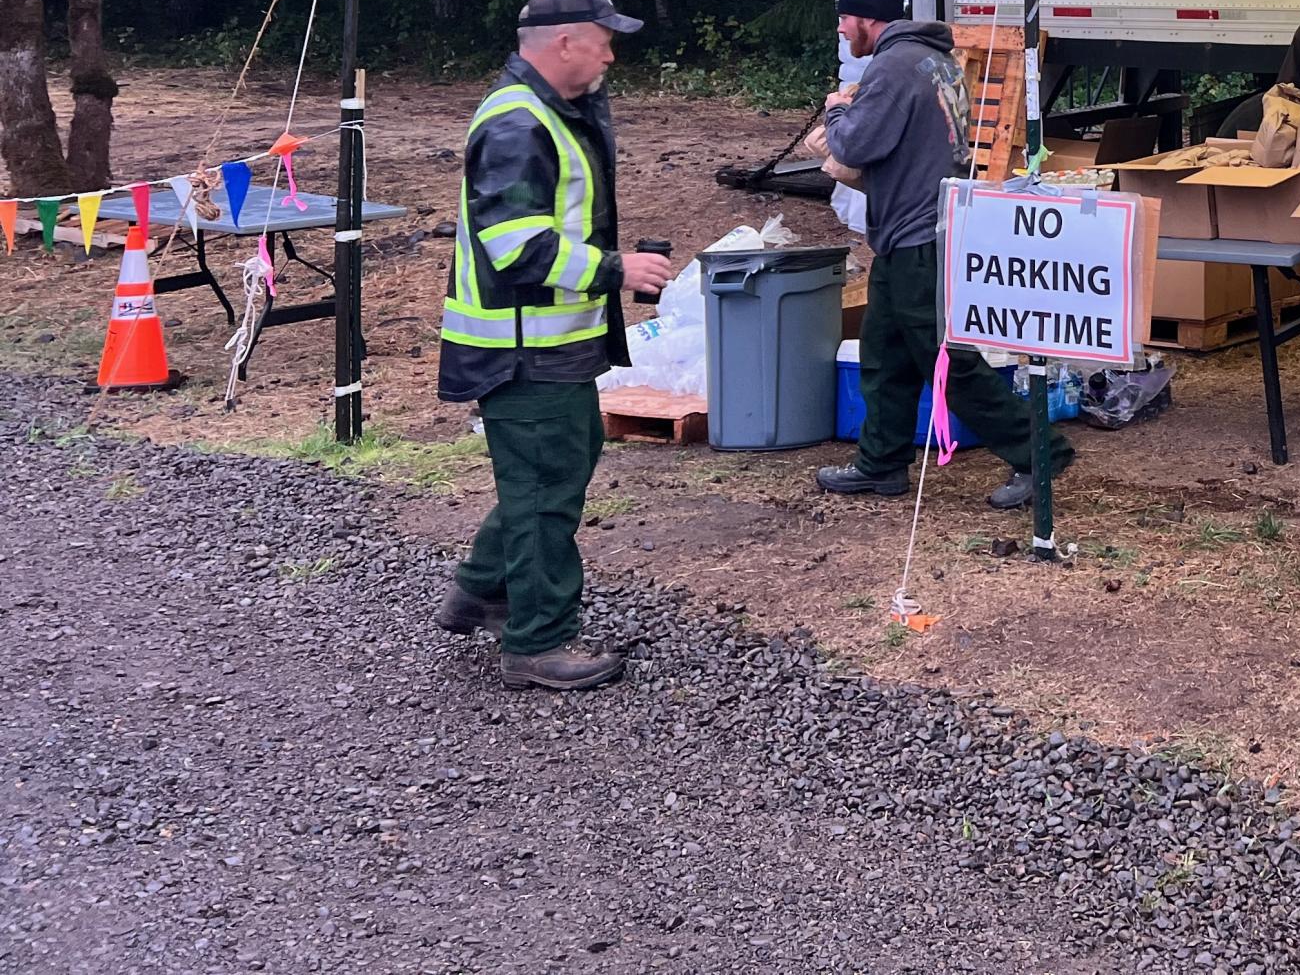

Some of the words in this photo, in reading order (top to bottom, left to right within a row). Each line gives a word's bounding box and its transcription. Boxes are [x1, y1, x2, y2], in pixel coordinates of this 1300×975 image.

[1014, 205, 1063, 239] NO
[966, 252, 1111, 296] PARKING
[964, 304, 1113, 349] ANYTIME
